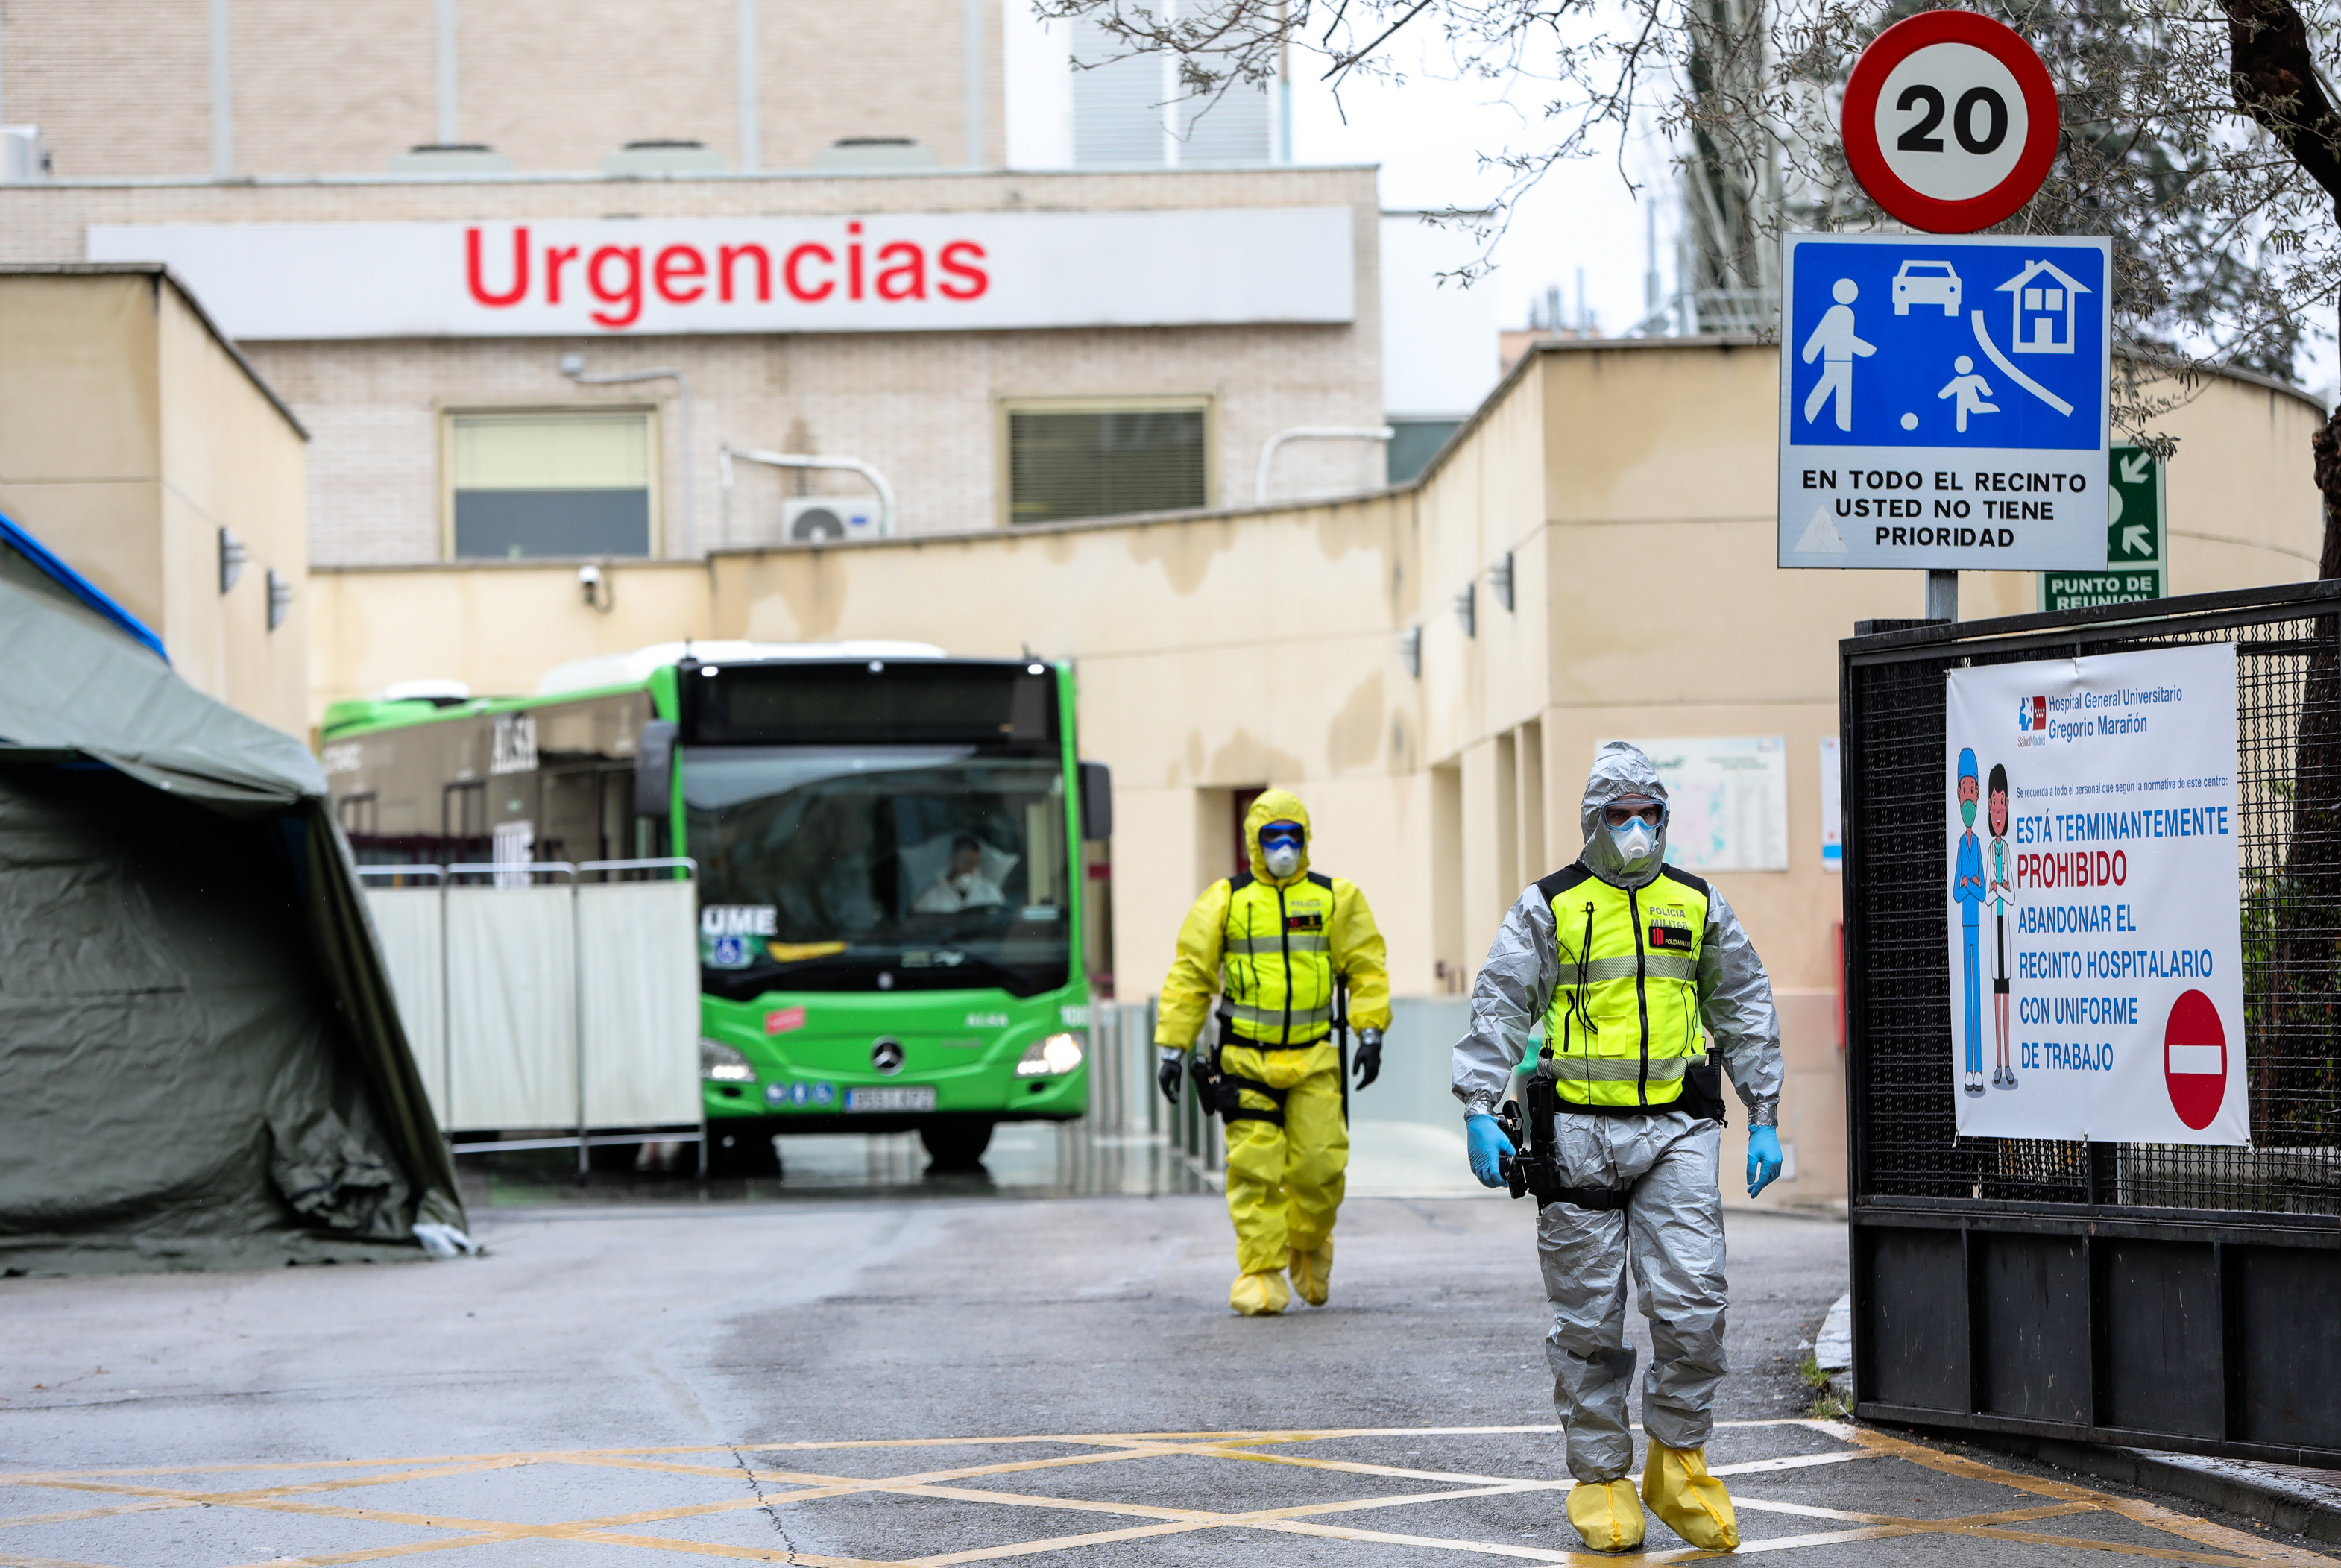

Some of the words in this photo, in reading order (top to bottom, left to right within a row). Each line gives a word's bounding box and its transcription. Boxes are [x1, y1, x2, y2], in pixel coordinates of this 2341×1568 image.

[1896, 85, 2008, 155] 20
[465, 221, 989, 328] Urgencias
[1803, 470, 1836, 488] EN
[1850, 470, 1922, 491] TODO
[1936, 472, 1962, 491] EL
[1976, 472, 2085, 493] RECINTO
[1836, 499, 1921, 517] USTED
[1935, 500, 1971, 518] NO
[1984, 500, 2054, 520] TIENE
[1876, 526, 2014, 547] PRIORIDAD
[2052, 577, 2120, 594] PUNTO
[2126, 576, 2152, 591] DE
[2049, 693, 2082, 714] Hospital
[2085, 690, 2120, 708] General
[2123, 685, 2182, 705] Universitario
[2018, 734, 2045, 747] SaludMadrid
[2049, 717, 2093, 743] Gregorio
[2098, 712, 2147, 735] Marañón
[2017, 787, 2023, 798] Se
[2025, 785, 2048, 797] recuerda
[2049, 788, 2053, 796] a
[2055, 784, 2067, 796] todo
[2069, 784, 2073, 795] el
[2075, 782, 2100, 797] personal
[2102, 784, 2114, 796] que
[2115, 780, 2134, 795] según
[2136, 780, 2142, 791] la
[2143, 778, 2175, 790] normativa
[2177, 778, 2185, 789] de
[2187, 778, 2201, 788] este
[2203, 776, 2228, 787] centro:
[2017, 809, 2052, 843] ESTÁ
[2056, 807, 2228, 842] TERMINANTEMENTE
[2018, 849, 2126, 888] PROHIBIDO
[702, 904, 778, 936] UME
[1650, 907, 1686, 918] POLICIA
[1651, 919, 1687, 929] MILITAR
[2018, 905, 2111, 933] ABANDONAR
[2117, 904, 2136, 932] EL
[2020, 951, 2081, 979] RECINTO
[2088, 949, 2213, 978] HOSPITALARIO
[2020, 998, 2049, 1024] CON
[2055, 997, 2137, 1025] UNIFORME
[2022, 1043, 2039, 1069] DE
[2044, 1043, 2113, 1071] TRABAJO
